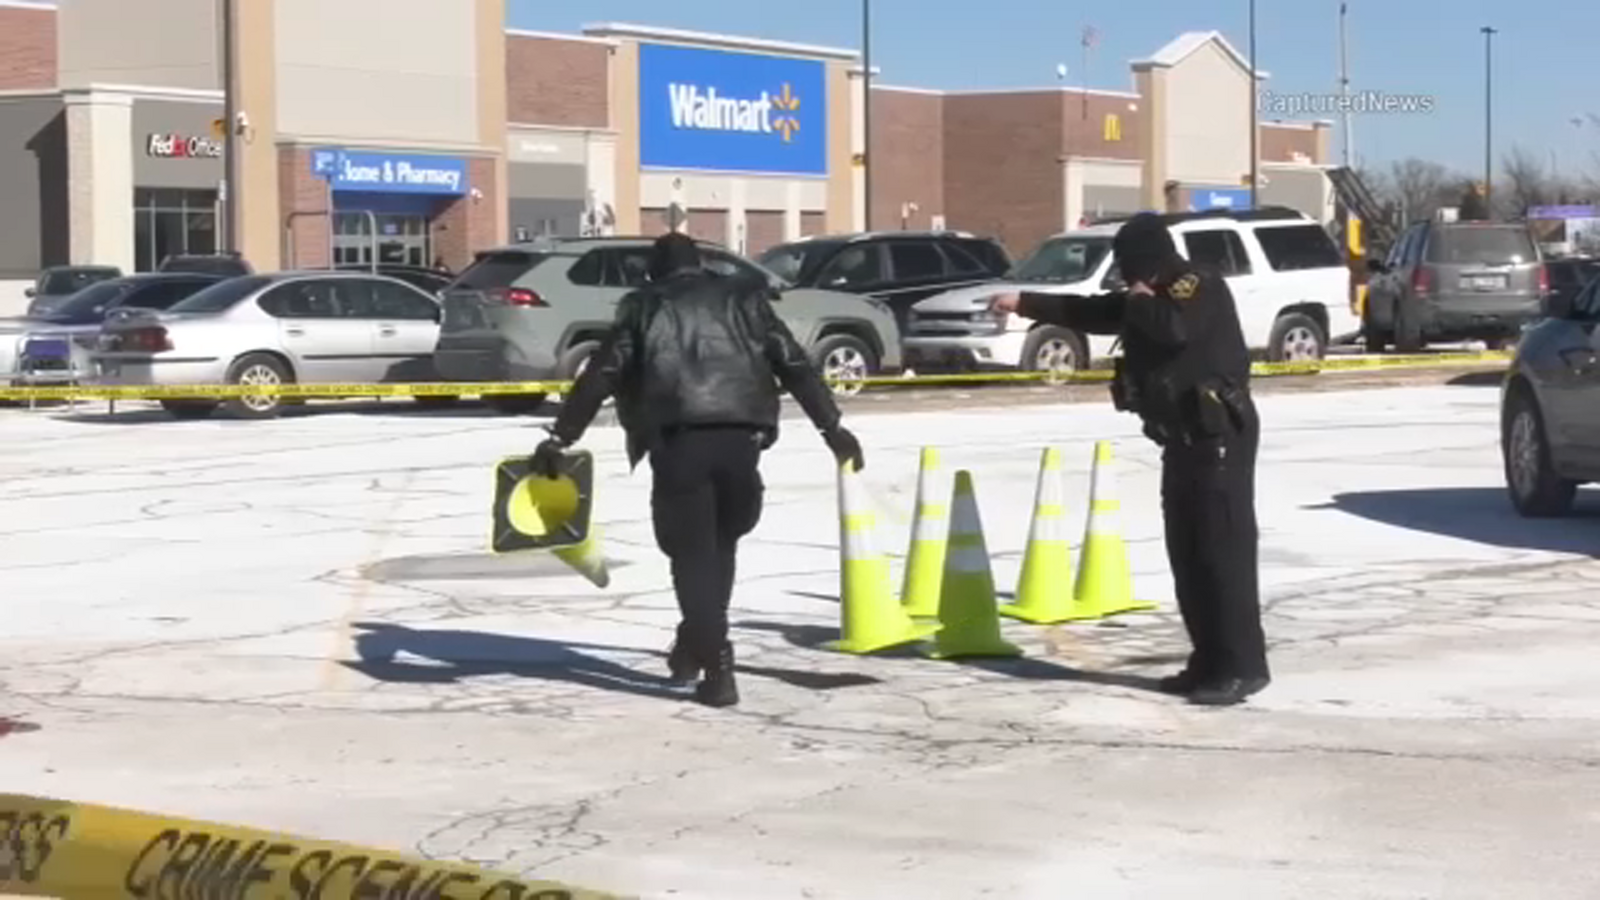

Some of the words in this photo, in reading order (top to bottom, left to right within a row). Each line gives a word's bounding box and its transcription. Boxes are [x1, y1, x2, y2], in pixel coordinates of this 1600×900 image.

[668, 82, 772, 133] Walmart
[147, 132, 186, 156] FedEx
[187, 135, 221, 157] Office
[383, 160, 394, 183] &
[396, 161, 461, 191] Pharmacy
[125, 829, 300, 900] CRIME
